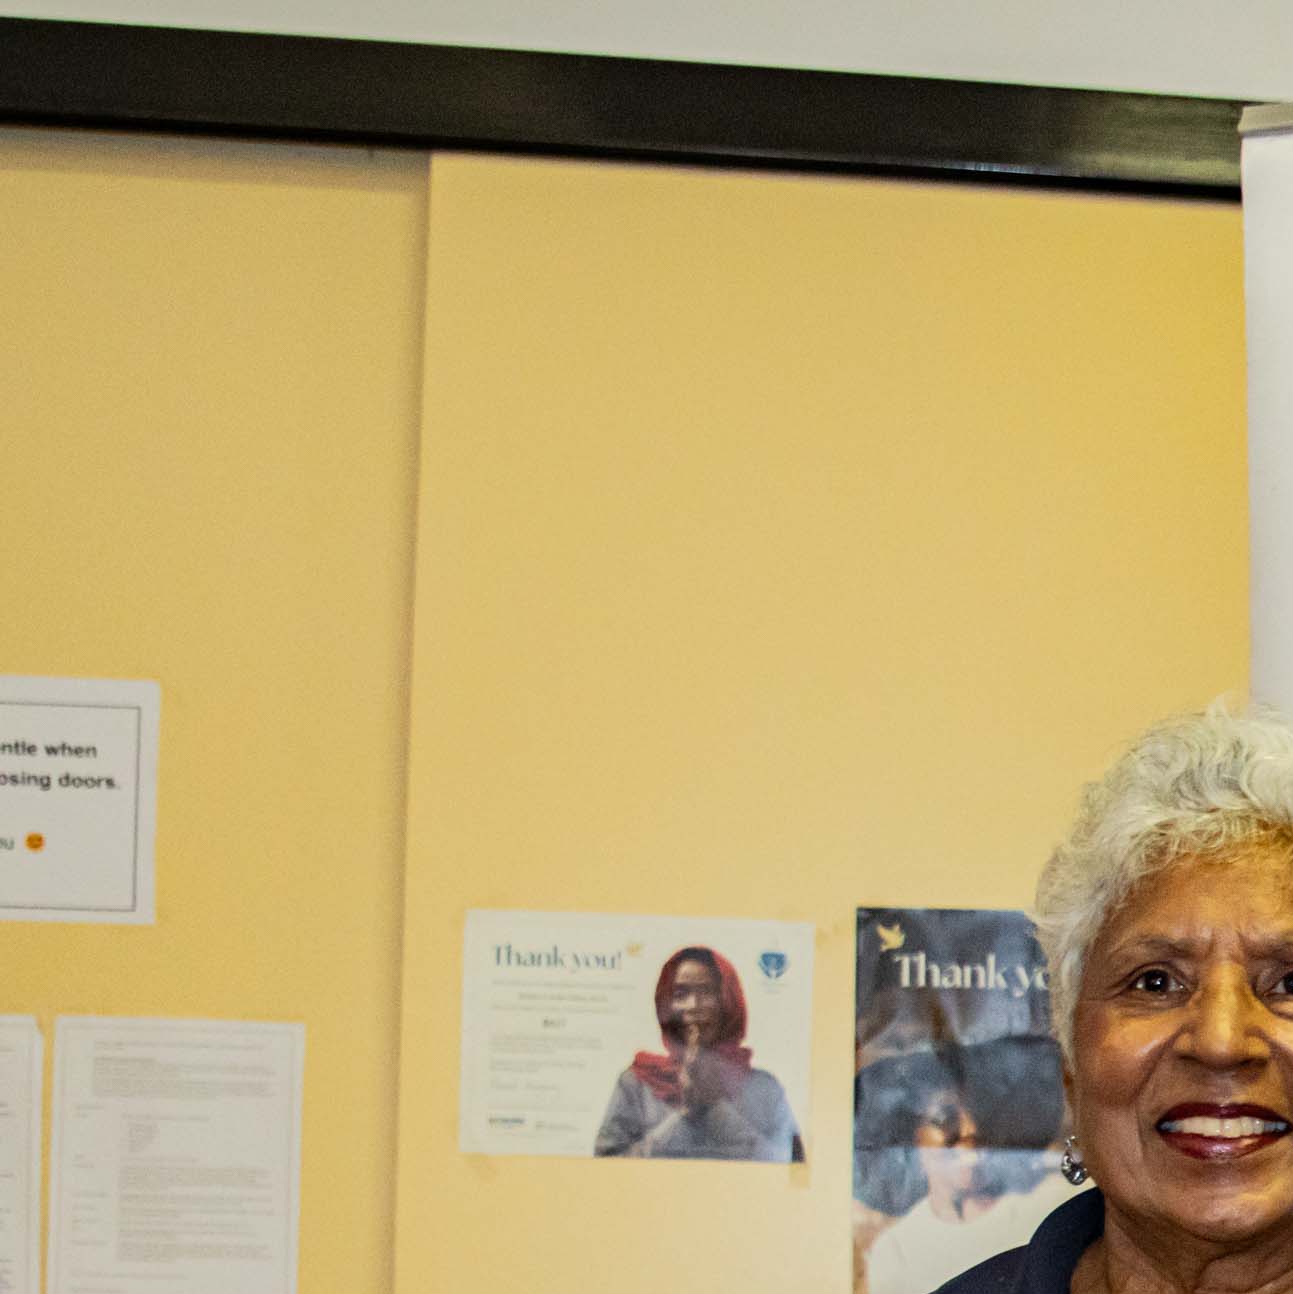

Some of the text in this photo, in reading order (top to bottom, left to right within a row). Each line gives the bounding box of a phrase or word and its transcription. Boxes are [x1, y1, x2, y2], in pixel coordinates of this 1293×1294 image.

[44, 742, 97, 758] when
[494, 944, 563, 967] Thank
[896, 953, 1005, 989] Thank
